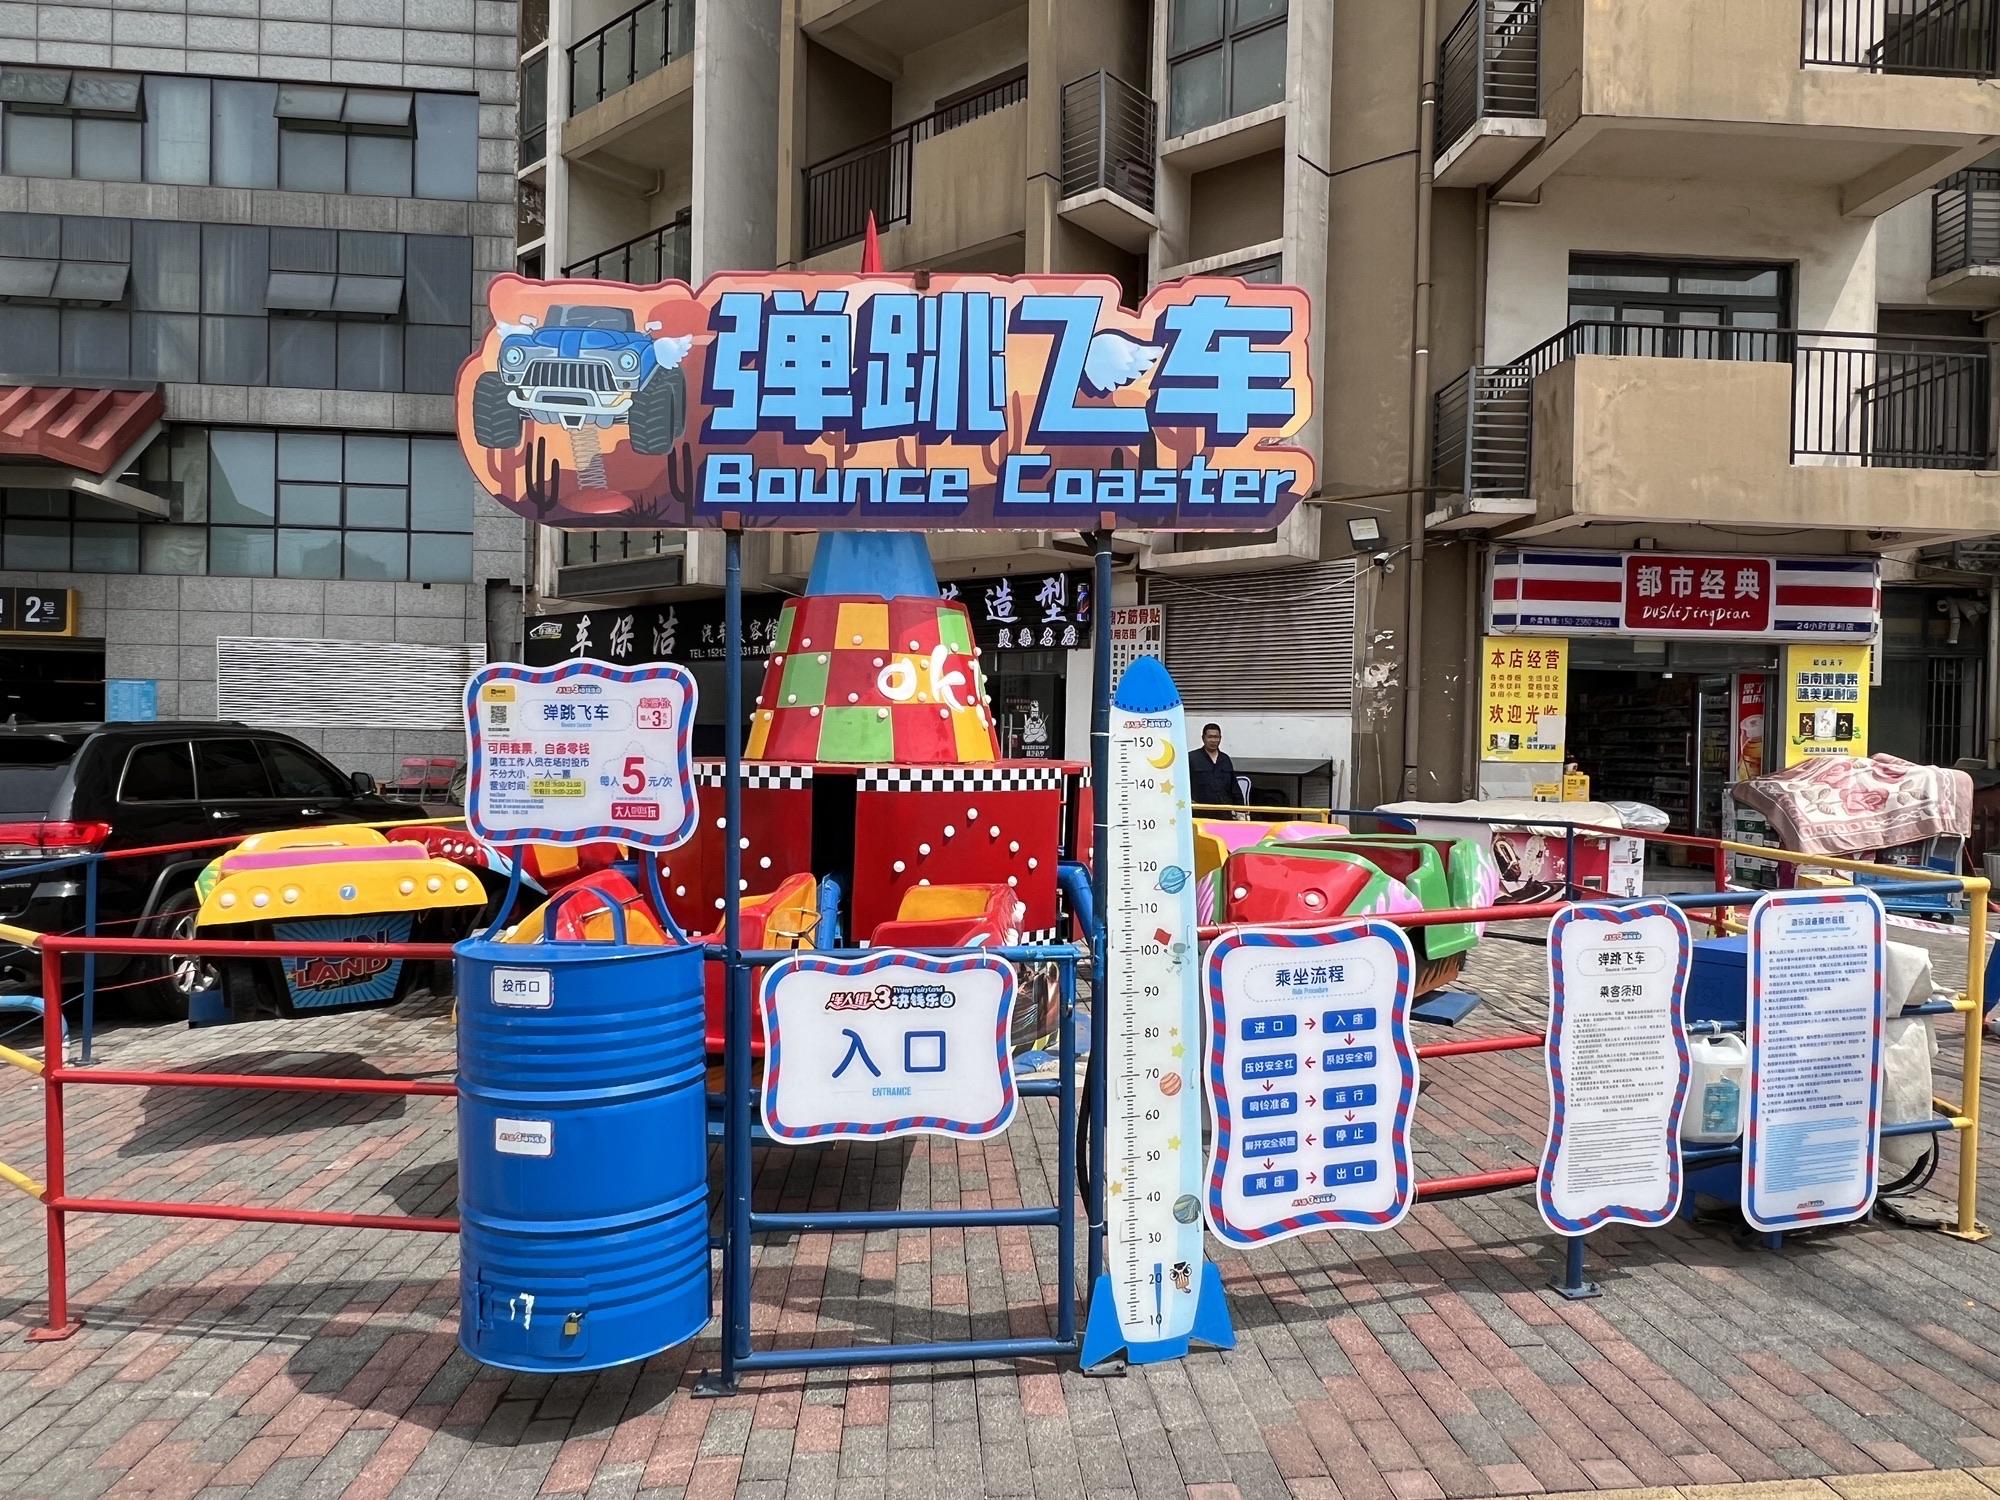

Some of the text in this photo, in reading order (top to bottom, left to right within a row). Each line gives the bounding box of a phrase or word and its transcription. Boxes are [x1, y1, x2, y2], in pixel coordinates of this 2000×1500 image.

[706, 290, 1296, 438] 弹跳飞车
[704, 454, 1295, 506] Bounce Coaster
[1637, 566, 1760, 599] 都市经典
[25, 596, 56, 623] 2号
[570, 606, 679, 657] 车保洁
[702, 618, 780, 644] 汽车容馆
[1796, 622, 1855, 631] 24小时便利店
[1111, 629, 1137, 640] 用范围
[690, 649, 705, 658] TEL:
[707, 647, 751, 657] 15213531
[1491, 648, 1559, 669] 本店经营
[543, 704, 609, 721] 弹跳飞车
[652, 711, 661, 726] 3
[1134, 737, 1153, 748] 150
[490, 757, 589, 768] 请在工作人员在场时投币
[622, 757, 646, 795] 5
[1135, 779, 1154, 789] 140
[1137, 820, 1156, 830] 130
[1138, 861, 1157, 872] 120
[344, 886, 351, 897] 7
[1140, 903, 1158, 913] 110
[1140, 945, 1159, 955] 100
[1598, 951, 1645, 966] 弹跳飞车
[296, 957, 388, 989] LAND
[1276, 966, 1345, 986] 乘坐流程
[502, 979, 540, 992] 投币口
[1144, 986, 1159, 997] 90
[1600, 985, 1642, 998] 乘客须知
[1254, 1013, 1363, 1034] 进口 入座
[1145, 1028, 1159, 1038] 80
[832, 1028, 946, 1078] 入口
[1145, 1069, 1160, 1079] 70
[872, 1087, 912, 1097] ENTRANCE
[1335, 1090, 1363, 1103] 运行
[1145, 1110, 1160, 1121] 60
[1336, 1128, 1364, 1141] 停止
[1146, 1151, 1160, 1161] 50
[1256, 1166, 1363, 1189] 离座 出口
[1147, 1191, 1161, 1202] 40
[1148, 1232, 1162, 1243] 30
[1149, 1273, 1162, 1284] 20
[1149, 1314, 1162, 1325] 10
